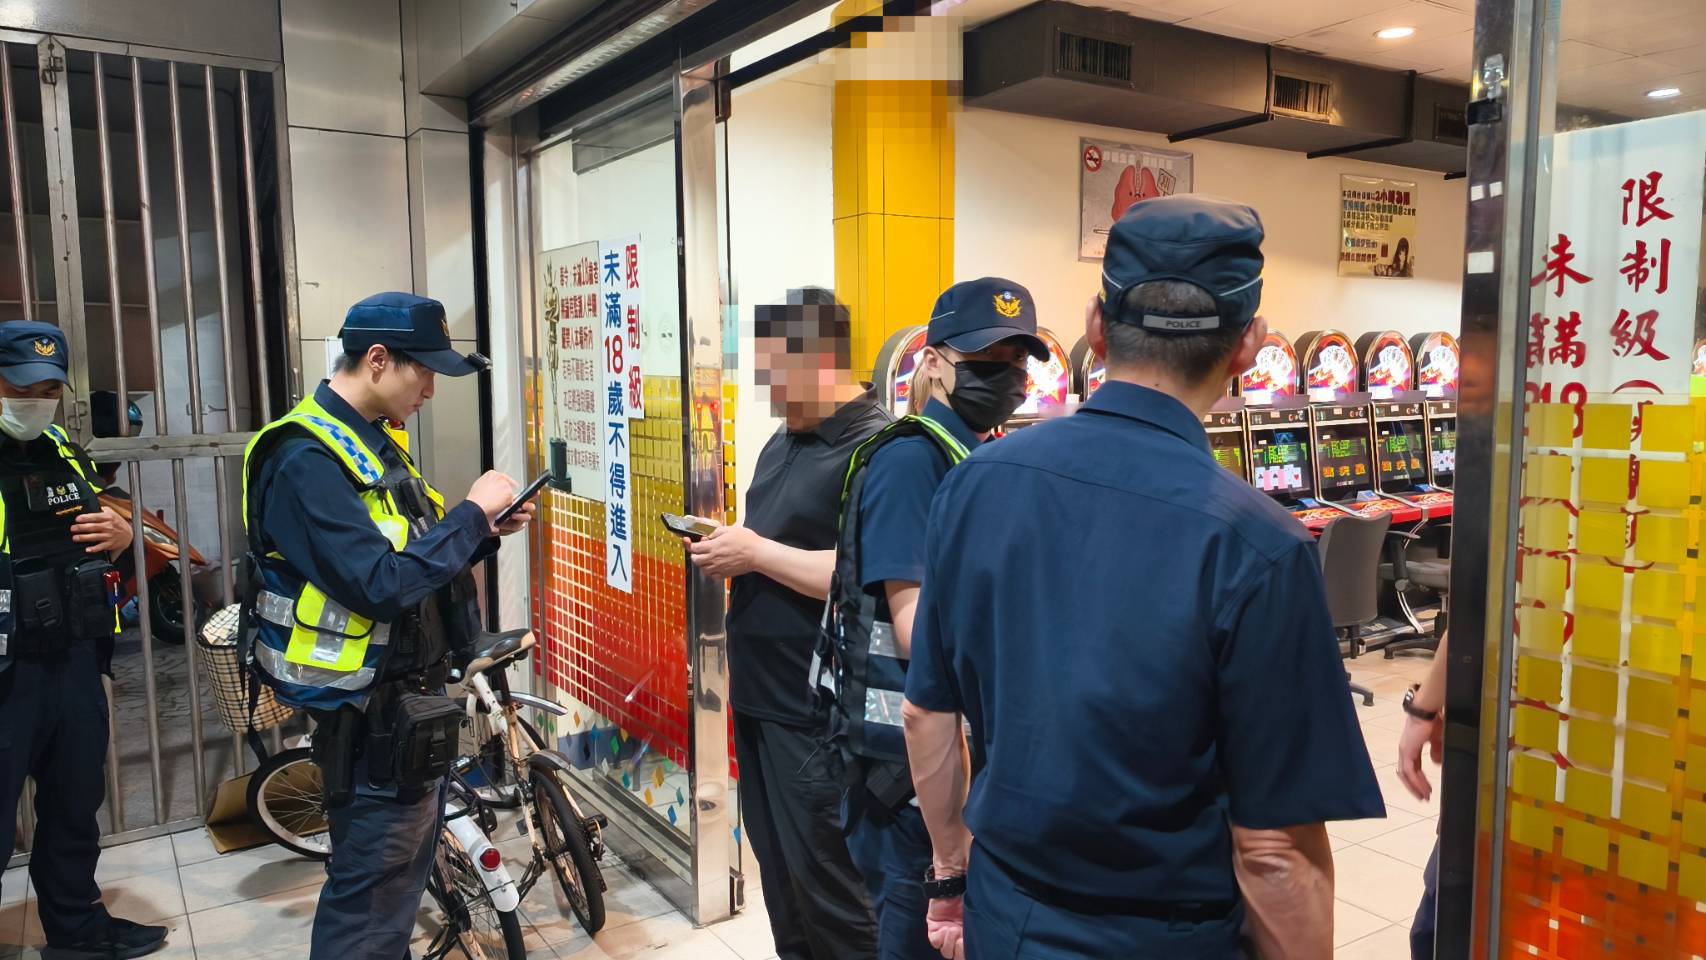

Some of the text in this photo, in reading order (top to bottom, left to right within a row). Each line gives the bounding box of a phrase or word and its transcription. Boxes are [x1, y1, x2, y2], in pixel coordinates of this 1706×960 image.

[625, 245, 642, 410] 限制級
[1166, 320, 1201, 329] POLICE
[603, 249, 628, 583] 未滿18歲不得進入
[48, 493, 80, 505] POLICE
